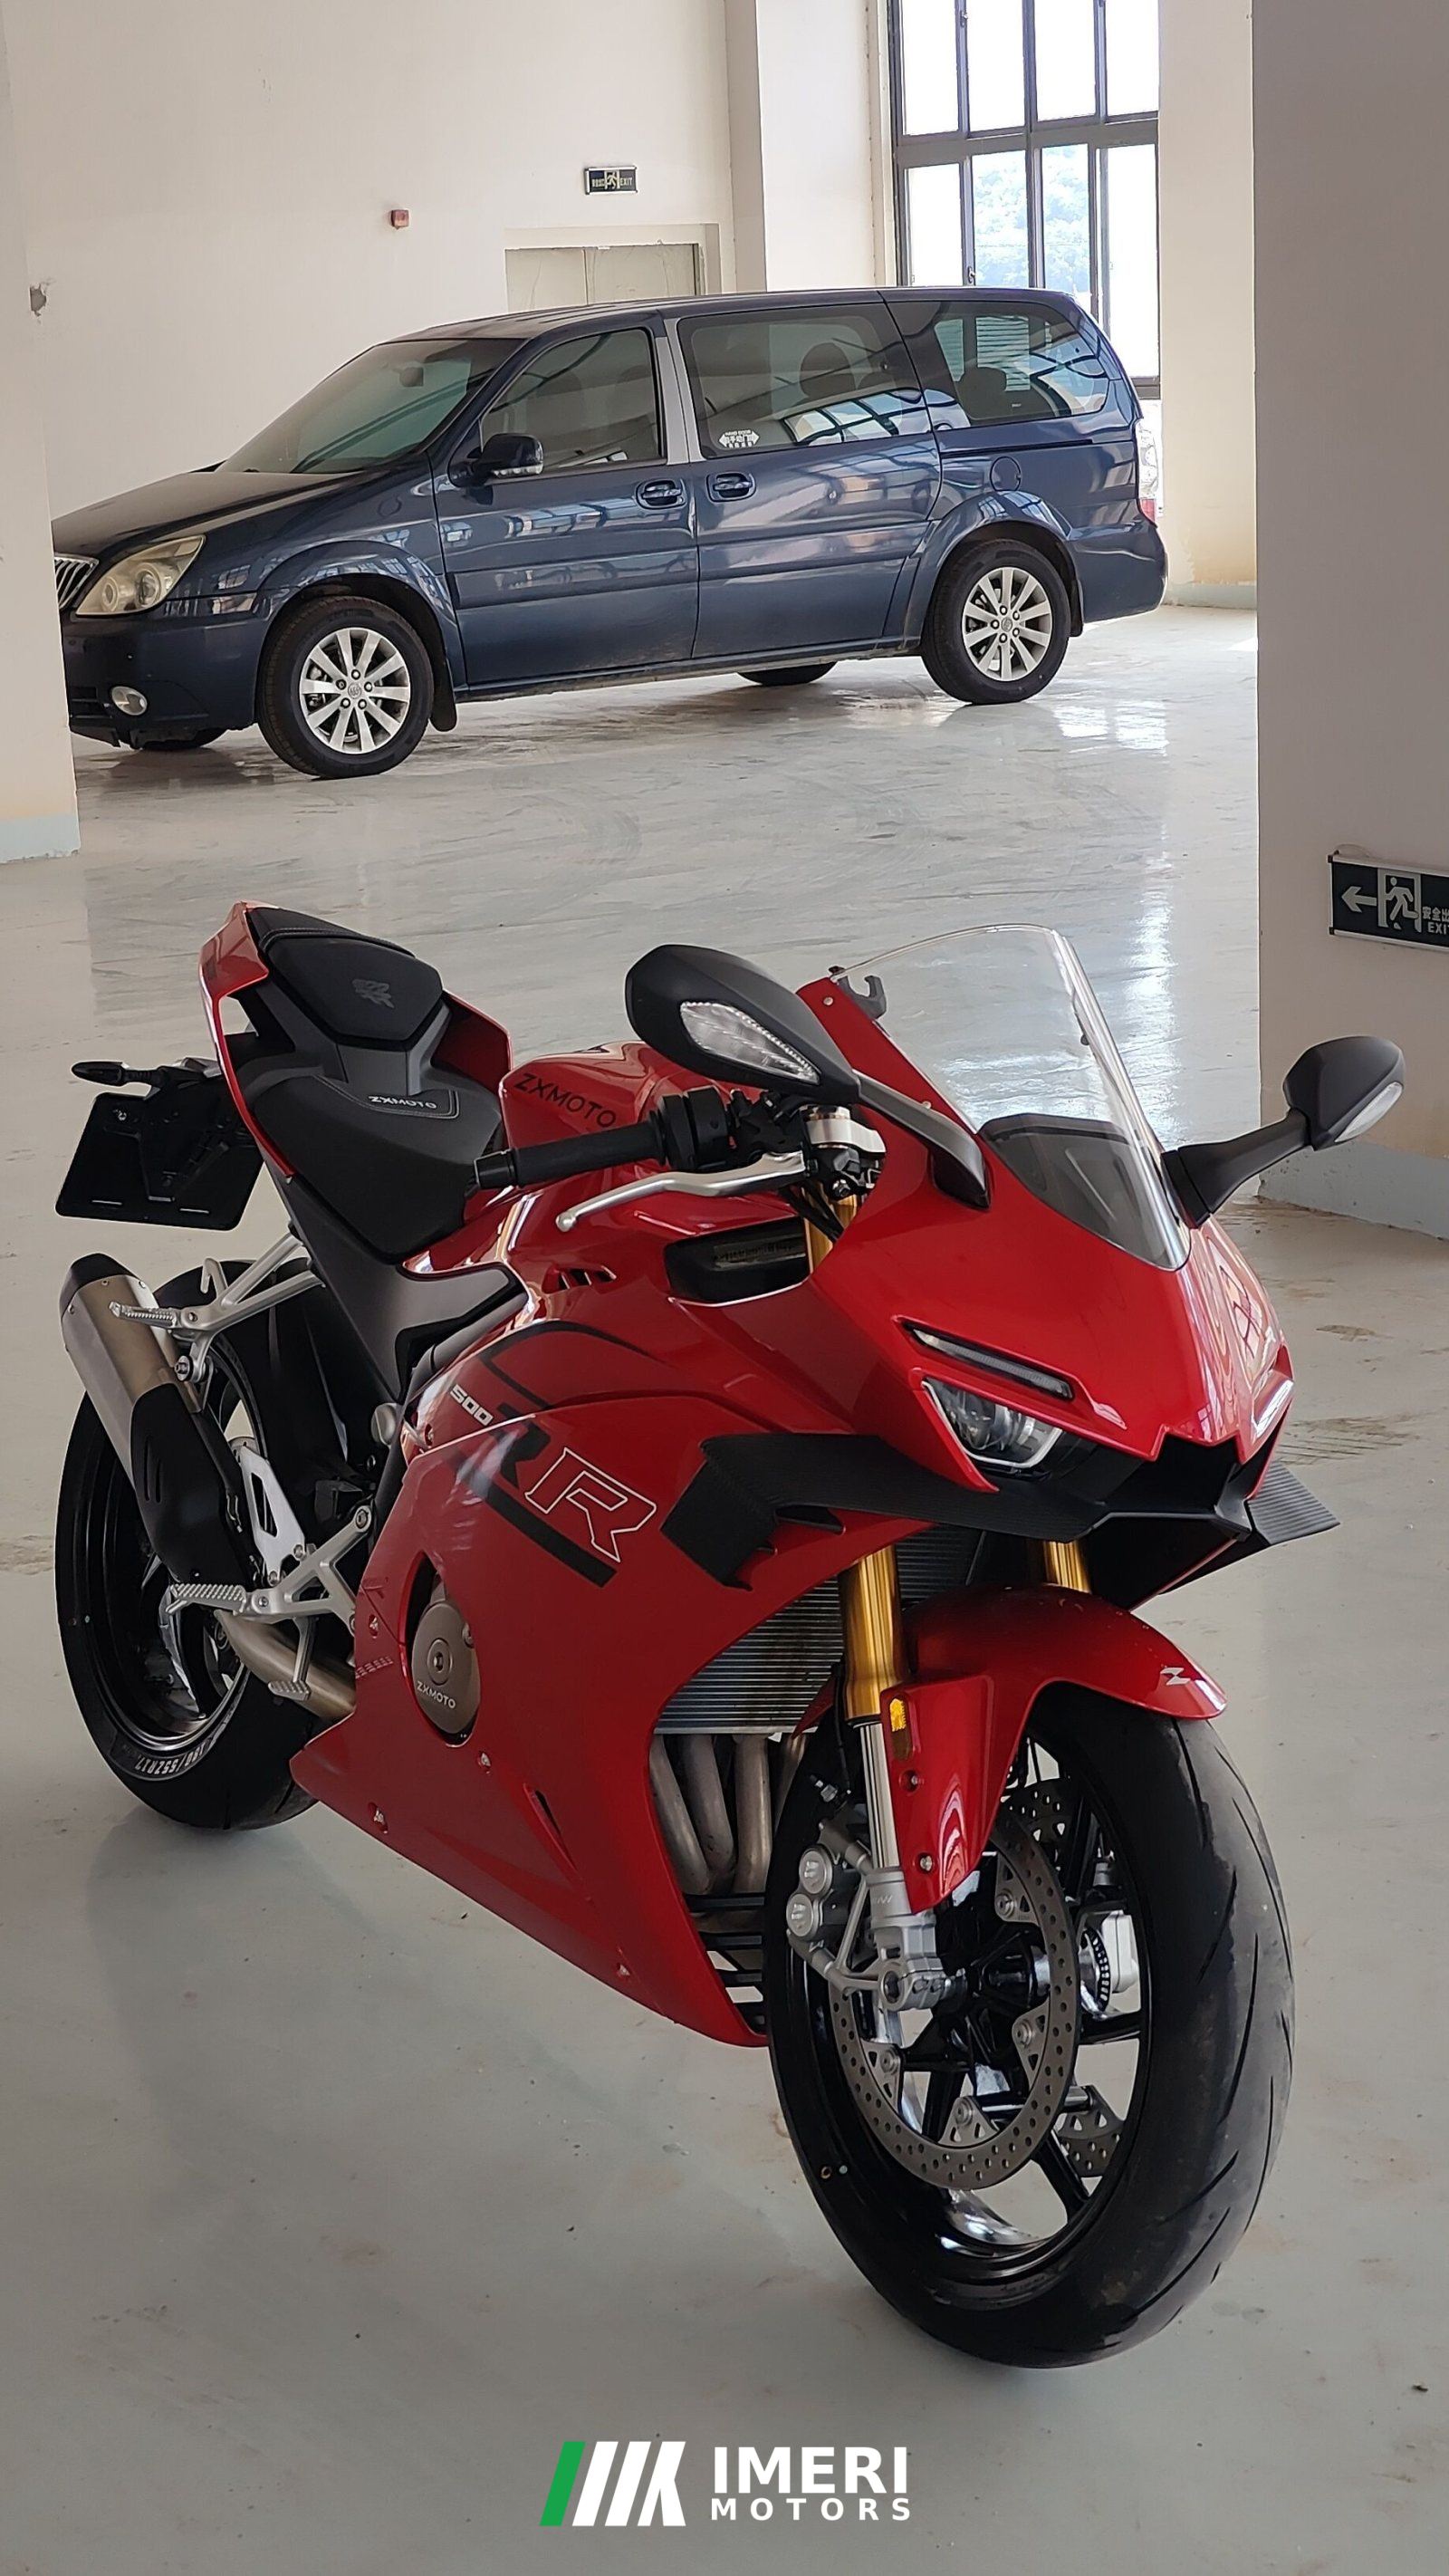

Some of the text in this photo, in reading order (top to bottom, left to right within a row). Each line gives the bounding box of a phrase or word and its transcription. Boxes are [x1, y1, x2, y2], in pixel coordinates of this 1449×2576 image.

[620, 178, 632, 186] EXIT
[368, 1095, 437, 1110] ZXMOTO
[514, 1072, 617, 1129] ZXMOTO
[450, 1384, 494, 1427] 500
[417, 1680, 456, 1709] ZXMOTO
